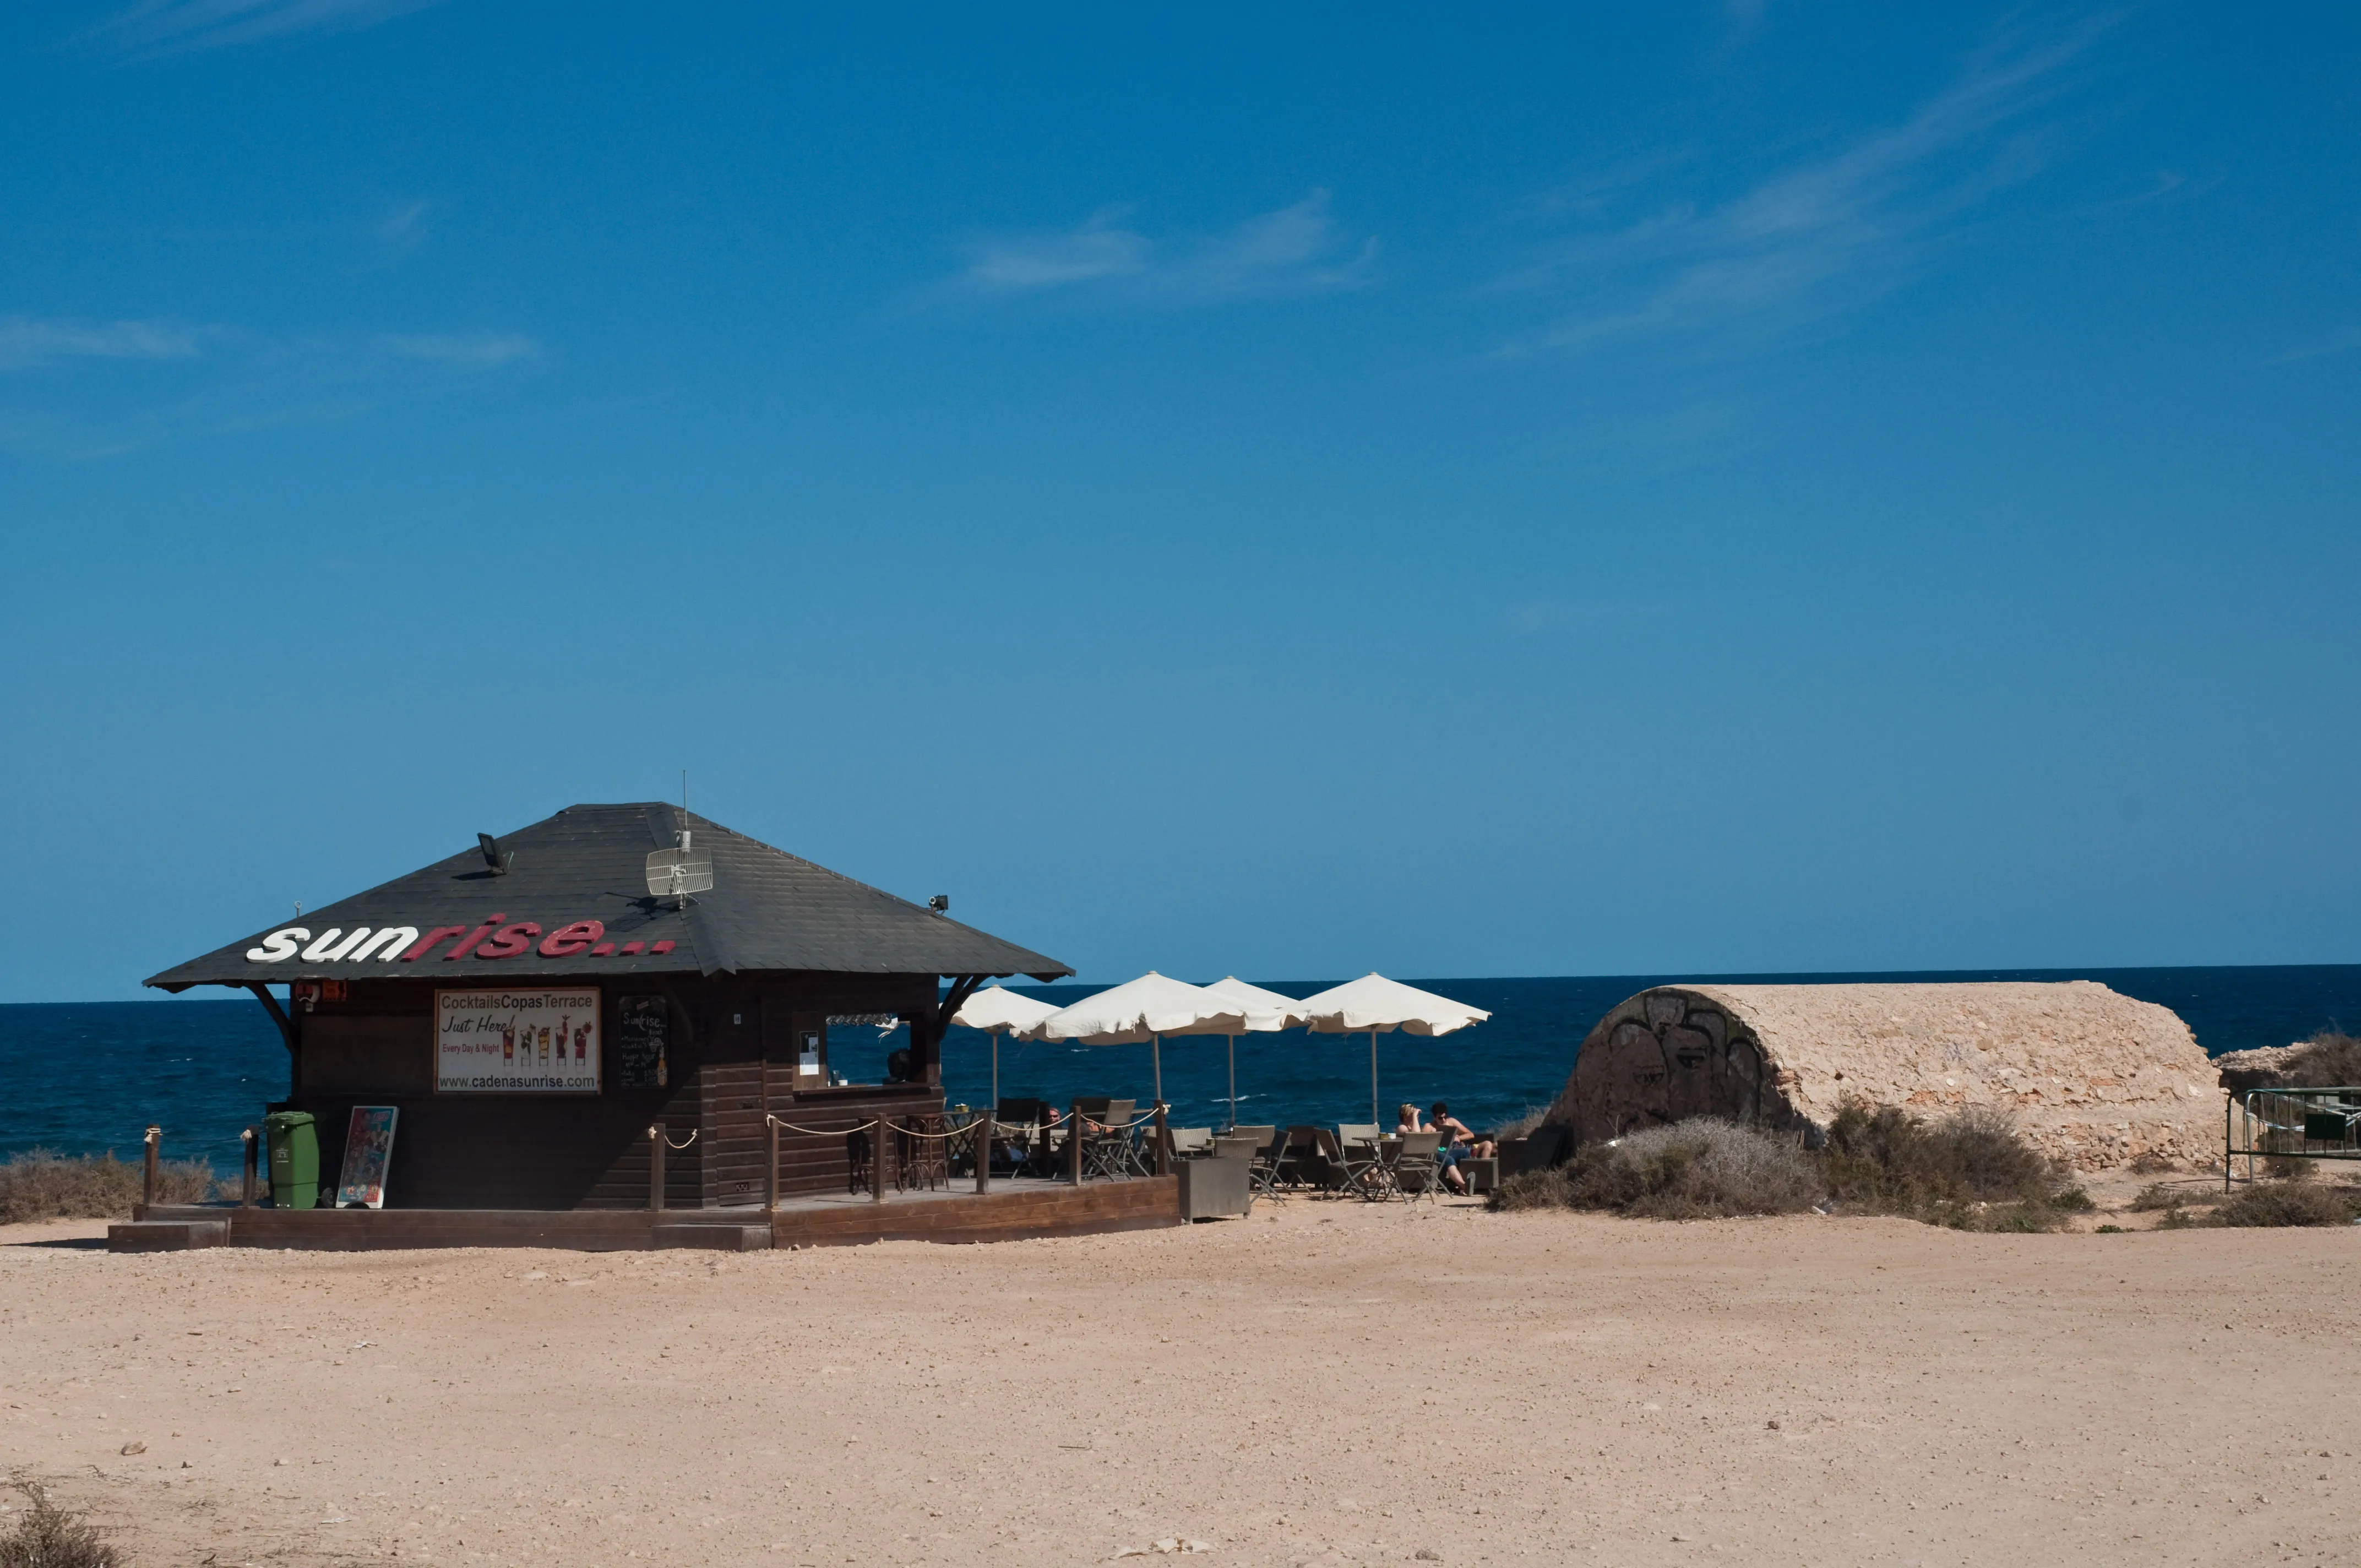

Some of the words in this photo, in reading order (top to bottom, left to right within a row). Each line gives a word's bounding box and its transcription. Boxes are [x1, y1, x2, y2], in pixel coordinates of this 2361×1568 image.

[442, 1016, 474, 1033] Just
[443, 1044, 460, 1054] Every
[462, 1044, 474, 1054] Day
[482, 1043, 499, 1054] Night
[439, 1075, 595, 1088] www.cadenasunrise.com
